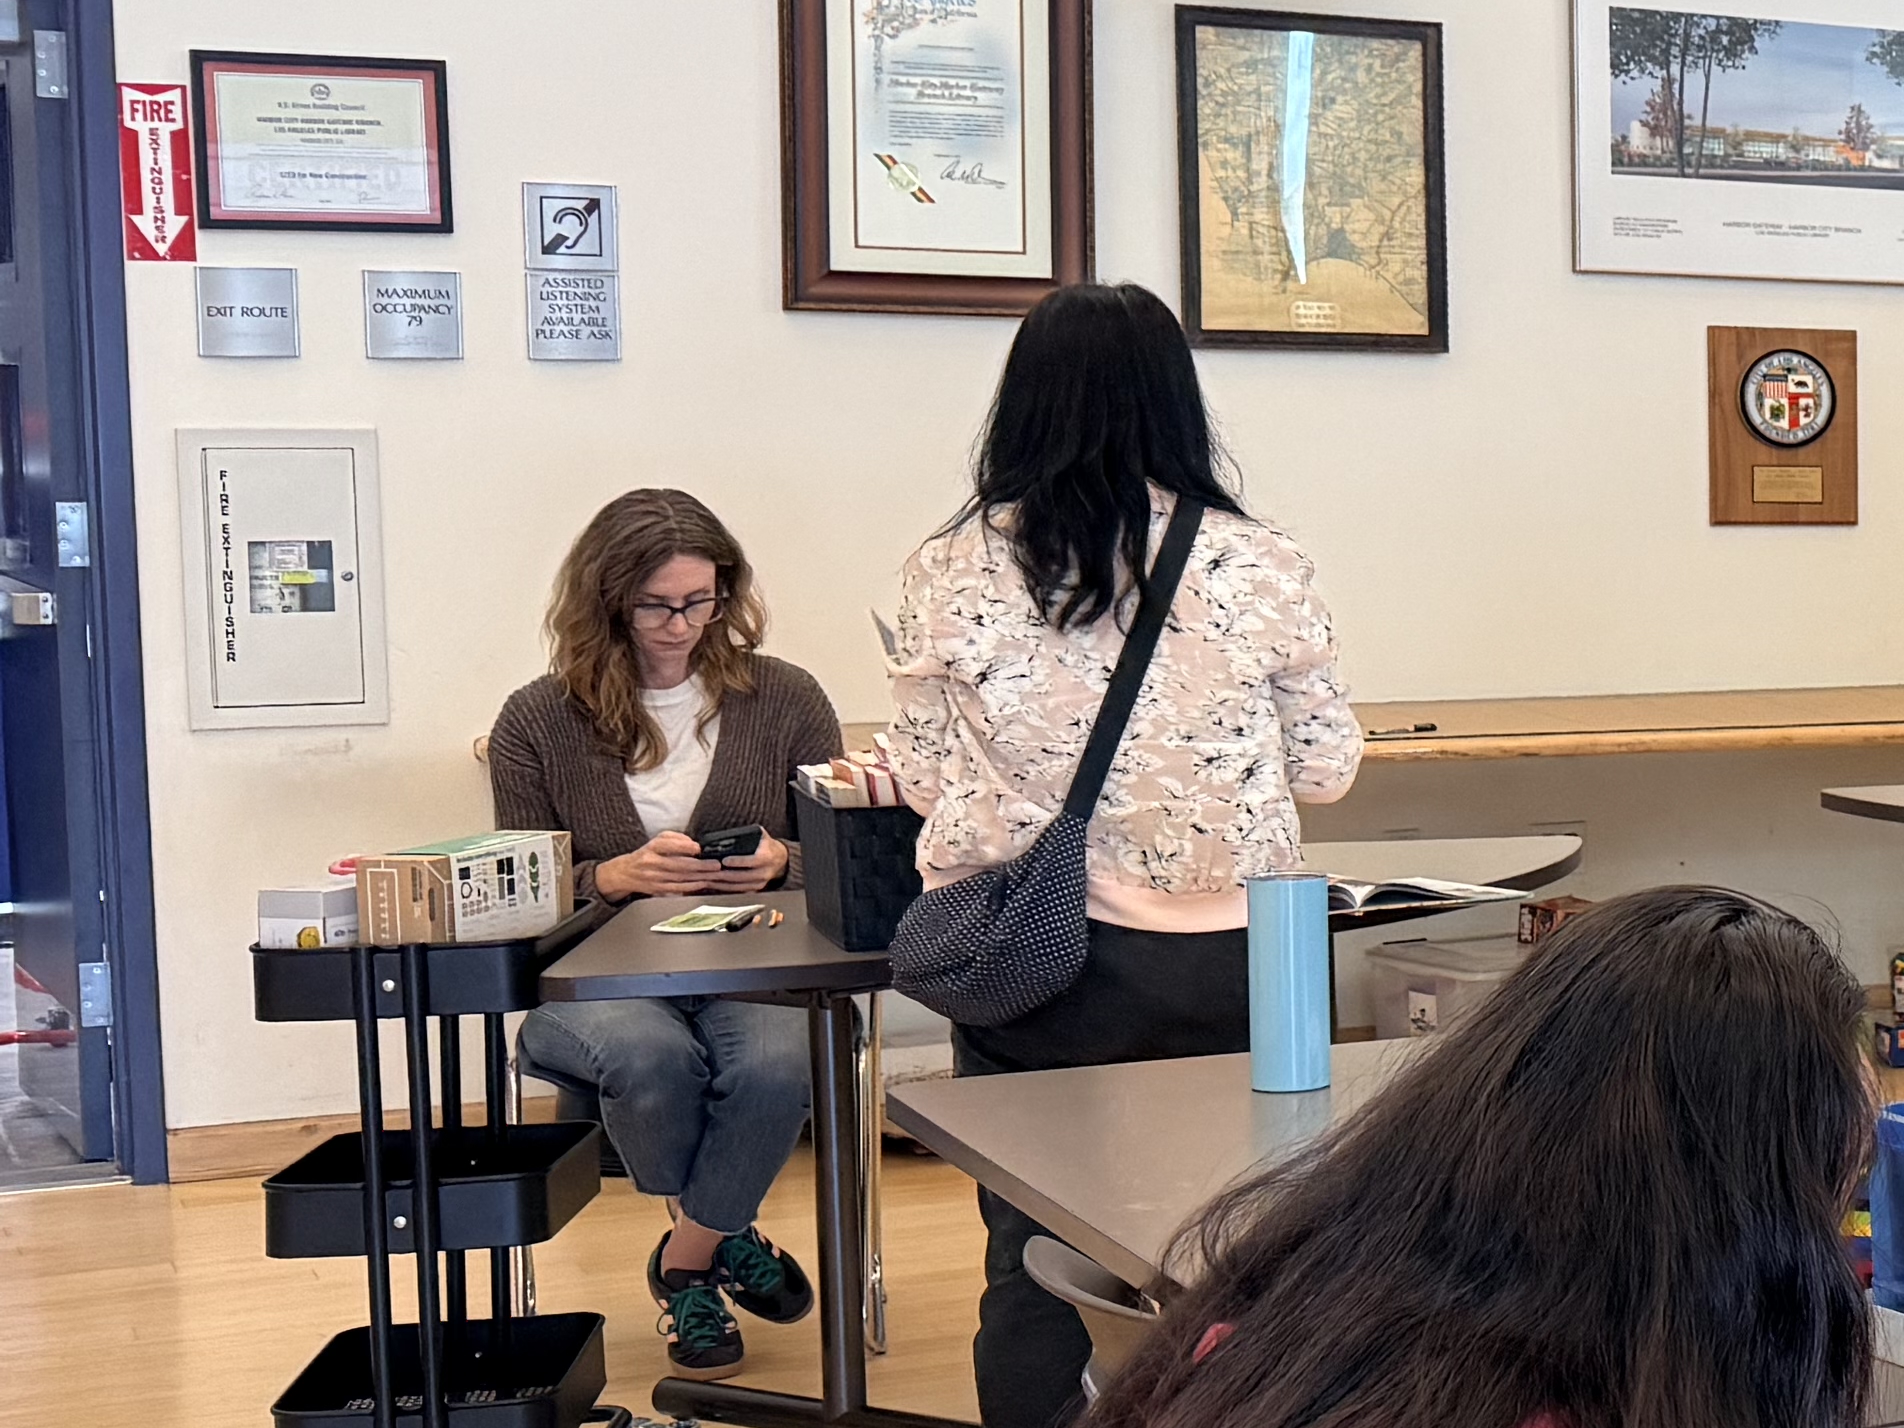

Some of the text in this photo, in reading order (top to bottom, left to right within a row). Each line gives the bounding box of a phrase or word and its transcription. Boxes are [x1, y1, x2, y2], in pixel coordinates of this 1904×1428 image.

[130, 99, 176, 123] FIRE
[541, 277, 604, 289] ASSISTED
[376, 288, 451, 301] MAXIMUM
[538, 290, 607, 302] LISTENING
[207, 305, 288, 318] EXIT ROUTE
[372, 303, 453, 316] OCCUPANCY
[547, 303, 600, 315] SYSTEM
[406, 315, 422, 327] 79
[540, 316, 608, 328] AVAILABLE
[534, 328, 613, 340] PLEASE ASK
[219, 470, 237, 663] FIRE EXTINGUISHER
